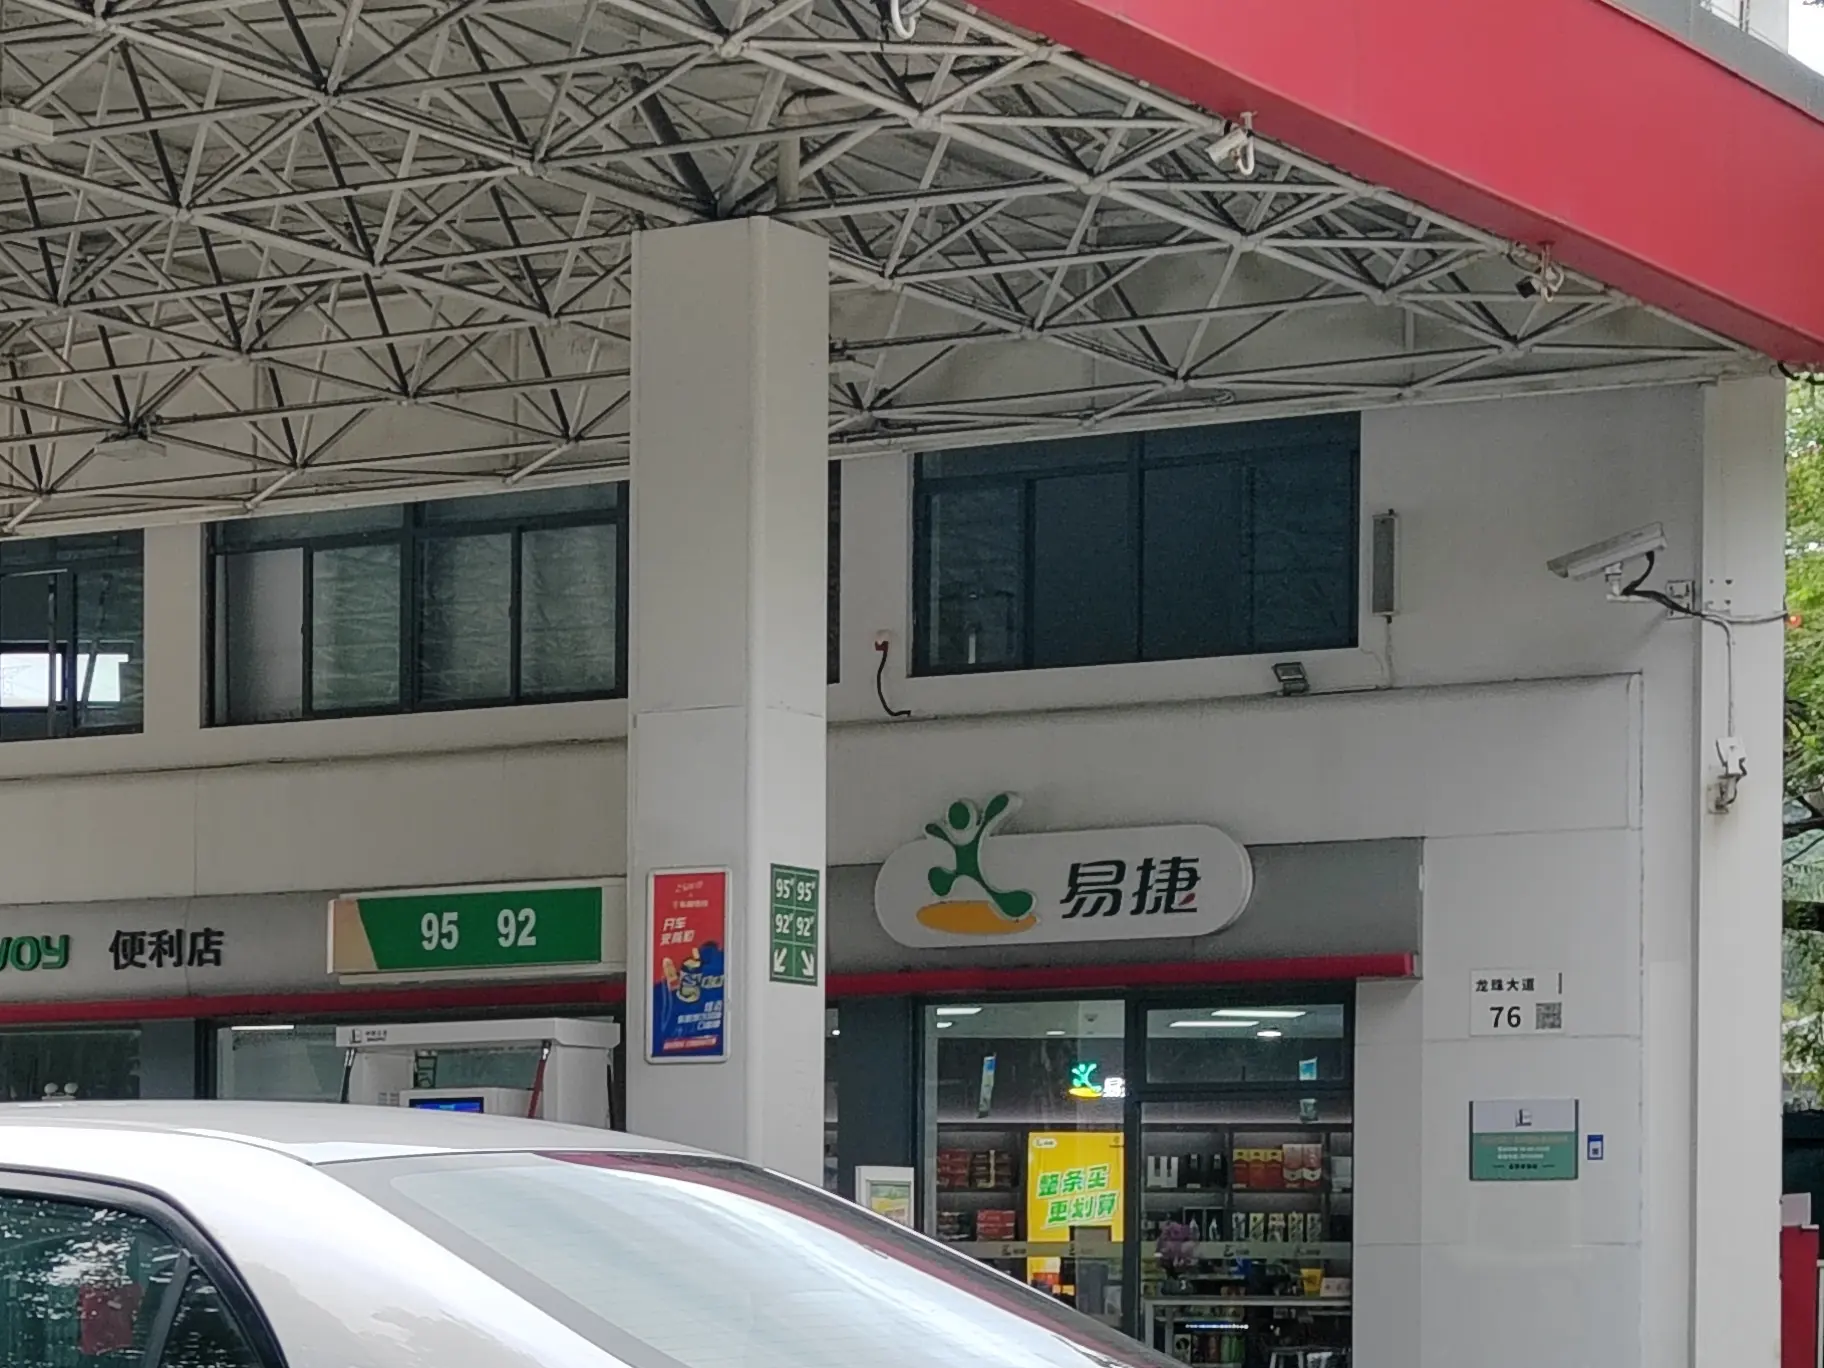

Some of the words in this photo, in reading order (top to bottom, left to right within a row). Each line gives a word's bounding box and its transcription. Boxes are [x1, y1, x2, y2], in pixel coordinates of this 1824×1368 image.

[1060, 856, 1201, 919] 易捷
[421, 911, 459, 951] 95
[497, 908, 536, 947] 92
[108, 927, 225, 971] 便利店
[1475, 978, 1535, 992] 龙珠大道
[1489, 1006, 1522, 1028] 76
[1102, 1077, 1126, 1098] 易
[1038, 1165, 1108, 1197] 整条买
[1048, 1192, 1117, 1223] 更划算
